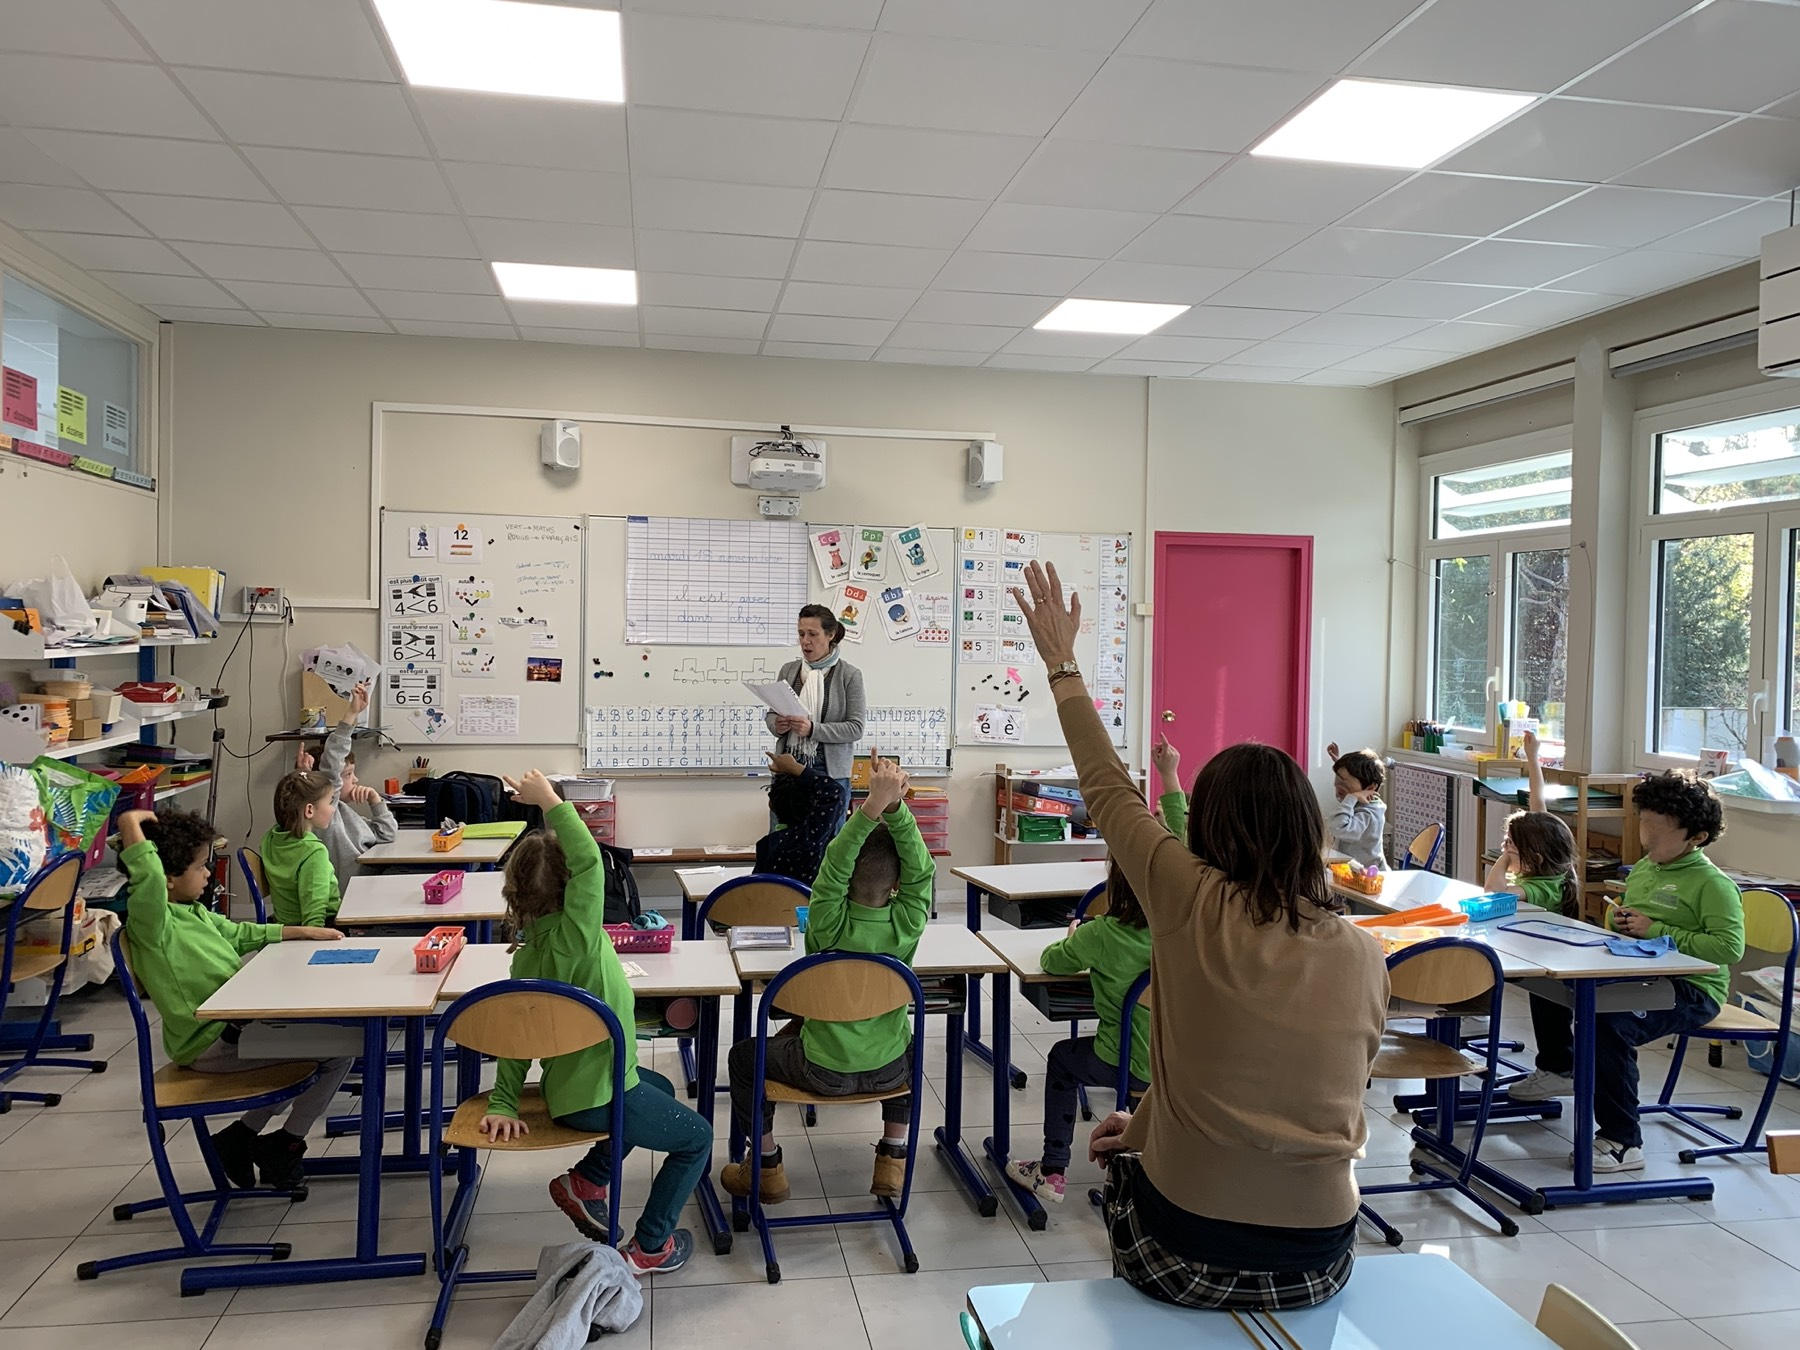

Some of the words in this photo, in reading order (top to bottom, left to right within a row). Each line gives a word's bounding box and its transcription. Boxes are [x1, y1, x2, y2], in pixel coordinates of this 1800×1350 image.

[453, 529, 469, 541] 12
[979, 531, 983, 540] 1
[1018, 535, 1026, 544] 6
[977, 561, 984, 571] 2
[1018, 562, 1024, 571] 7
[977, 590, 984, 600] 3
[678, 610, 712, 623] dans
[976, 612, 983, 622] 4
[1016, 615, 1023, 625] 9
[975, 642, 982, 651] 5
[1015, 642, 1025, 651] 10
[981, 718, 991, 734] é
[1004, 719, 1014, 735] è
